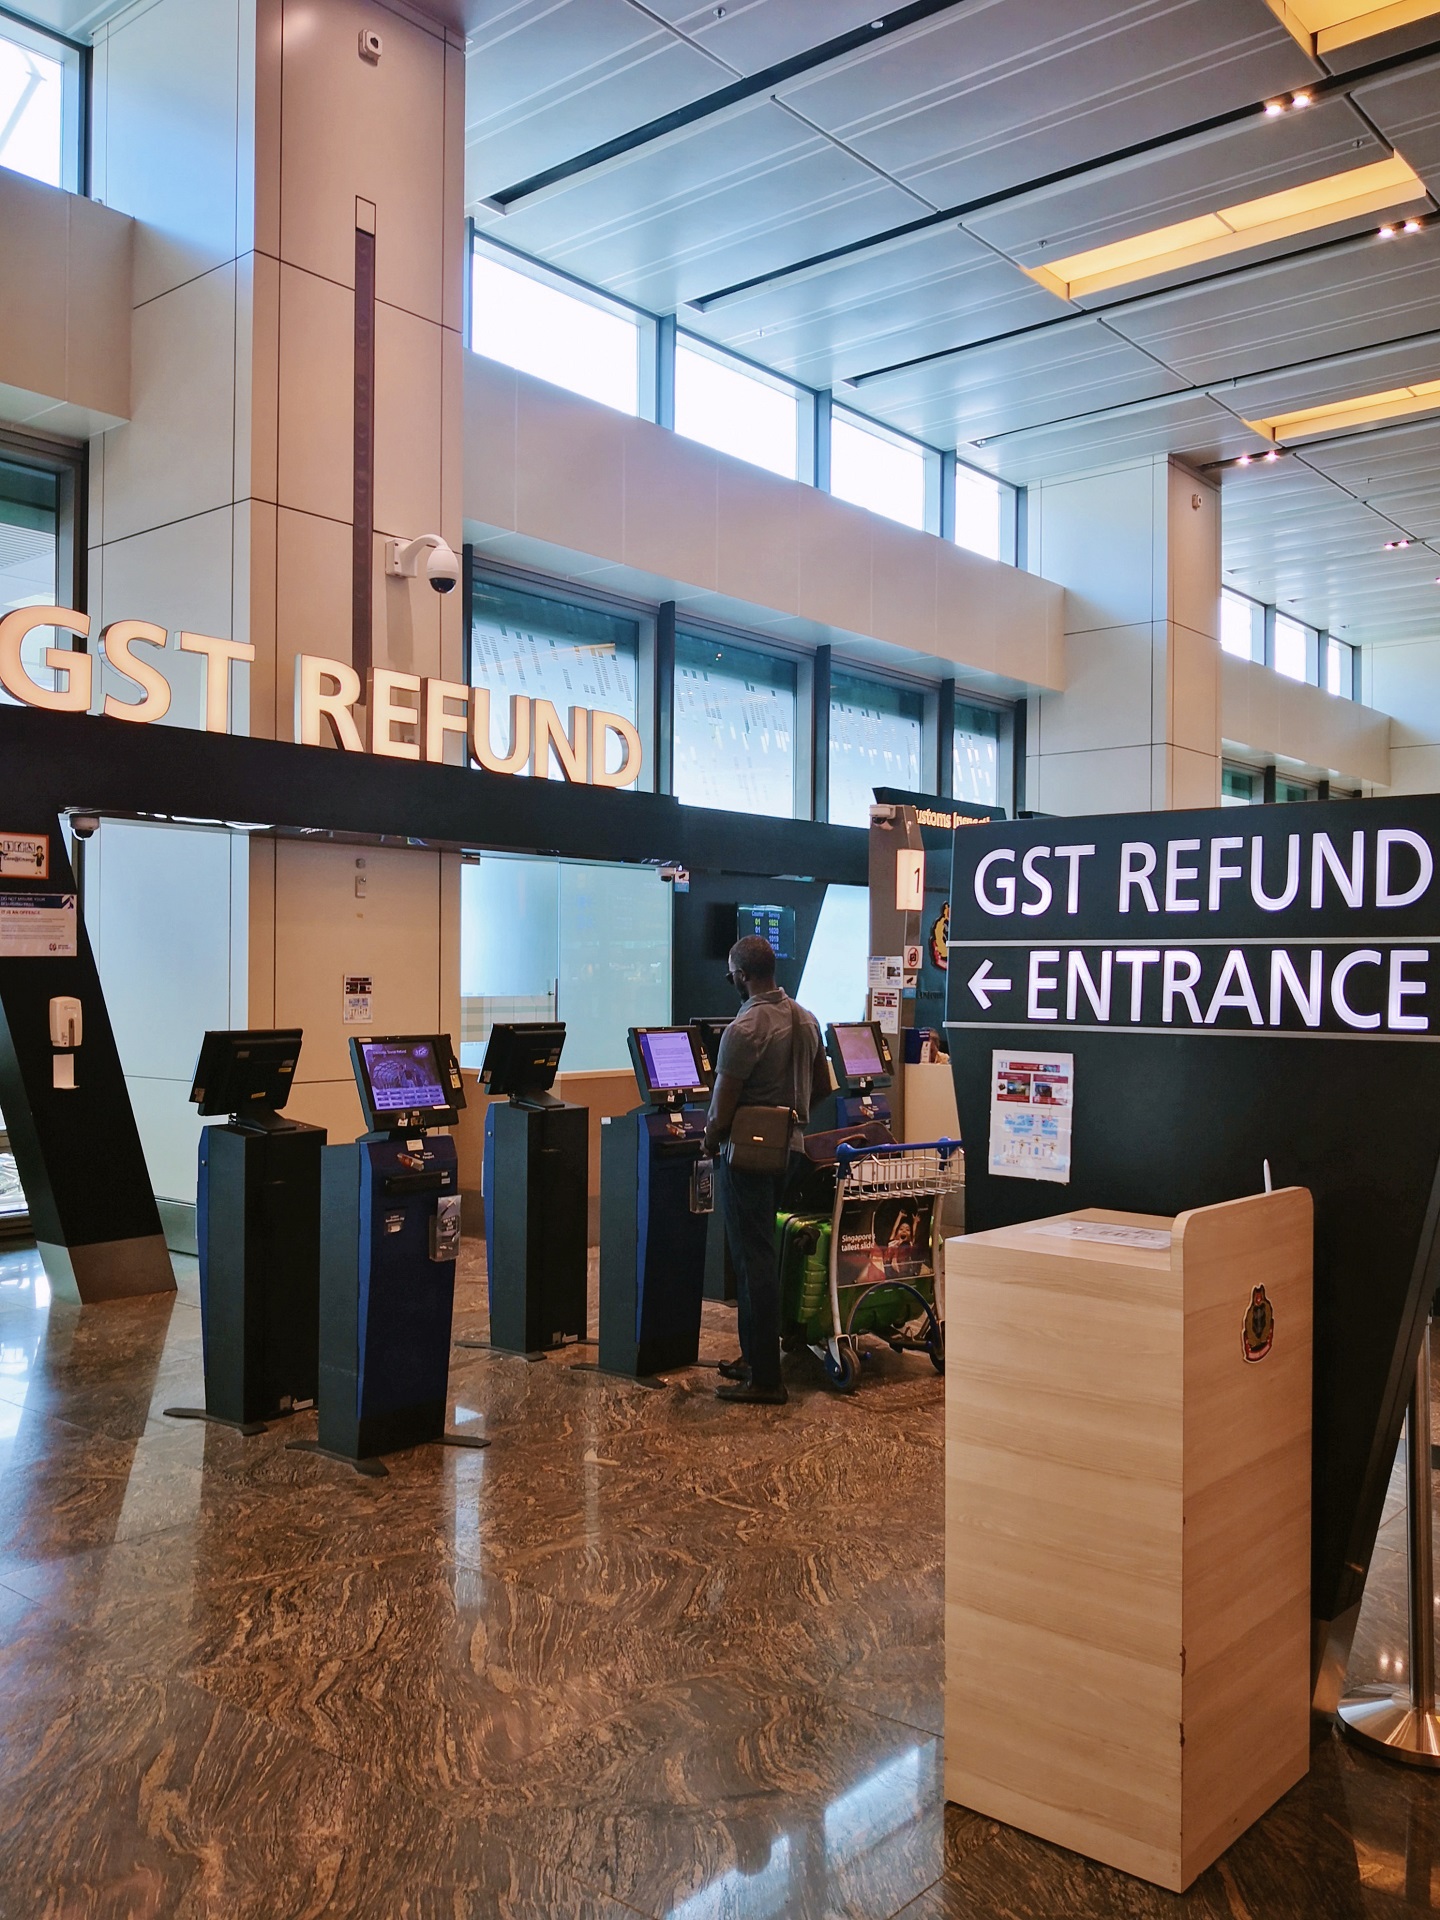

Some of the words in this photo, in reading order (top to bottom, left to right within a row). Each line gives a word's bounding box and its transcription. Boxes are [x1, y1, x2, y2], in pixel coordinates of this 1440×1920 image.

[0, 605, 255, 734] GST
[294, 653, 642, 787] REFUND
[914, 867, 921, 894] 1
[974, 845, 1096, 916] GST
[1118, 829, 1434, 912] REFUND
[1027, 950, 1429, 1030] ENTRANCE
[841, 1244, 859, 1252] tallest
